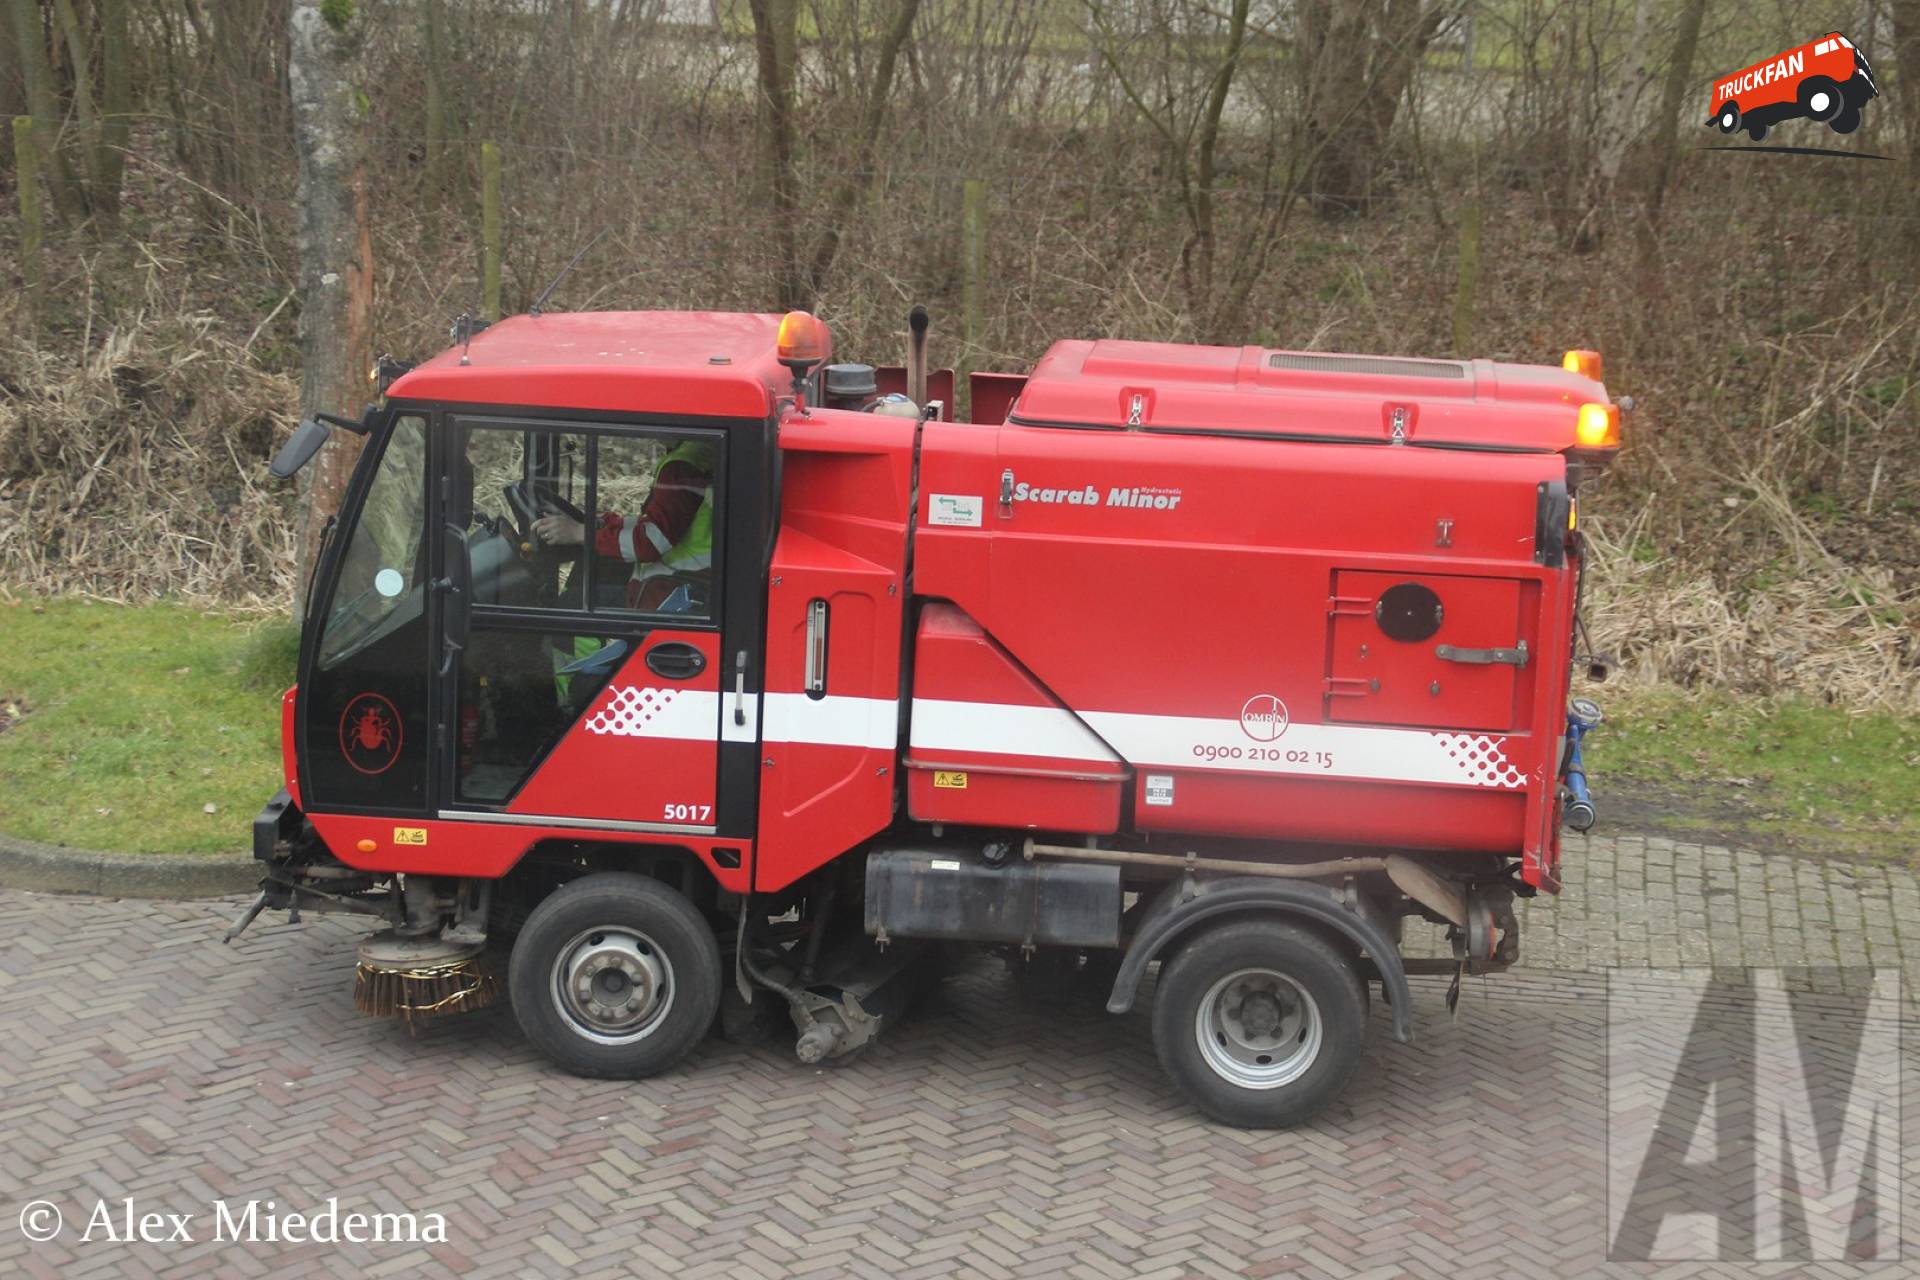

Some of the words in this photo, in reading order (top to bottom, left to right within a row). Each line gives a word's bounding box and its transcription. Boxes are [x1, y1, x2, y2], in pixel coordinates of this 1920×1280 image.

[1013, 482, 1100, 506] Scarab
[1106, 487, 1181, 510] Minor
[1244, 710, 1286, 723] OMRIN
[1193, 744, 1242, 761] 0900
[1248, 748, 1281, 761] 210
[1286, 750, 1309, 763] 02
[1316, 752, 1333, 768] 15
[663, 804, 711, 821] 5017
